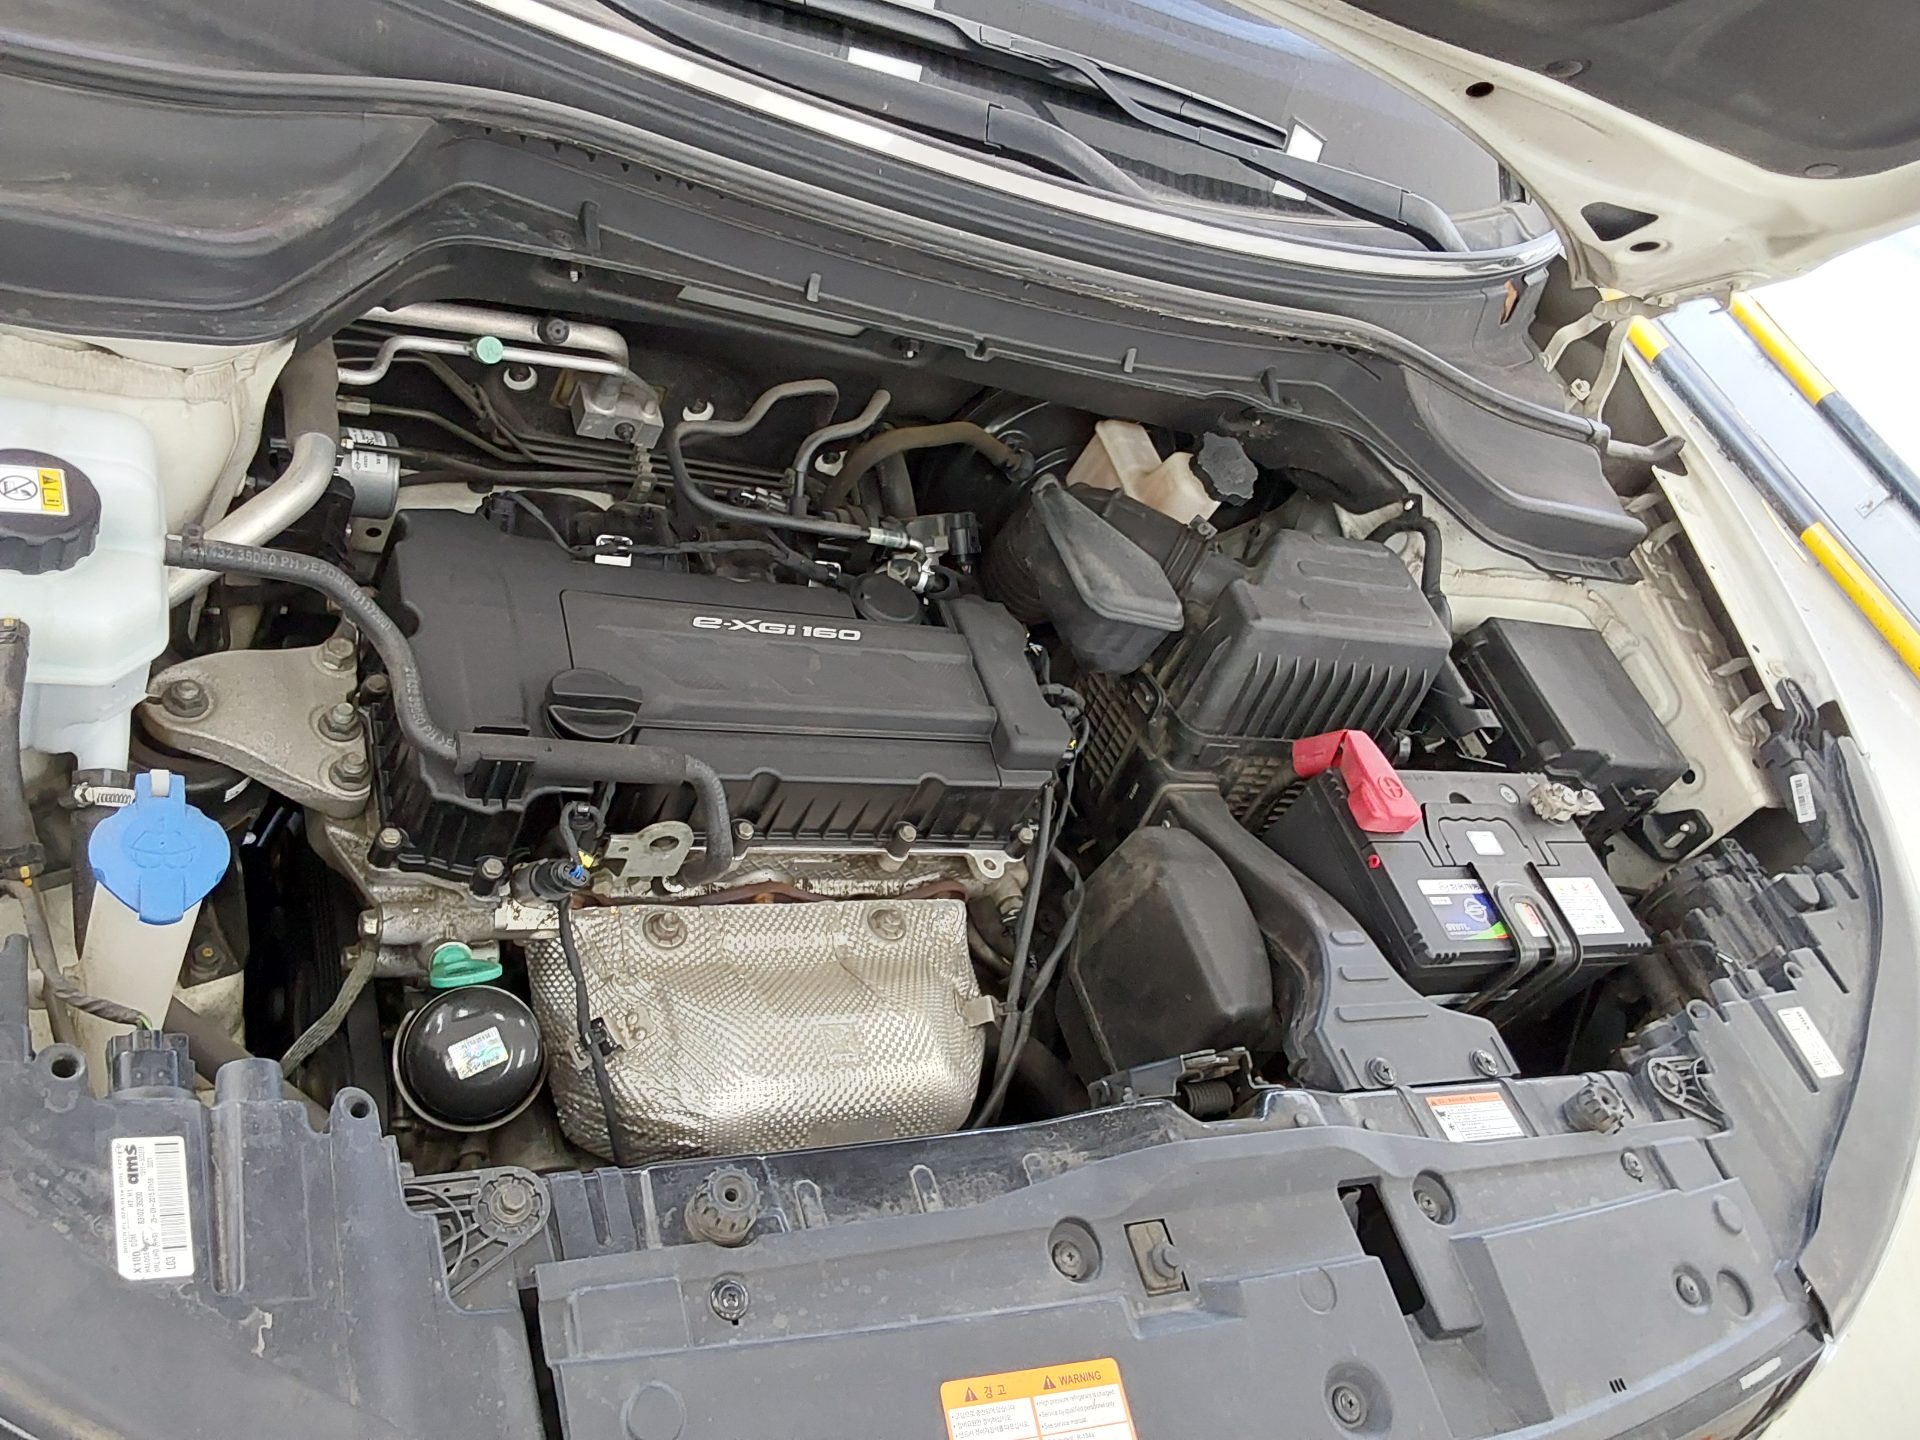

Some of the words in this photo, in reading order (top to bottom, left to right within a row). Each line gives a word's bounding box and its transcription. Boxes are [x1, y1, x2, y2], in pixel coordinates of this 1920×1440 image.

[802, 626, 861, 641] 160
[125, 1144, 139, 1184] ams
[165, 1256, 176, 1270] L03
[1058, 1370, 1102, 1386] WARNING
